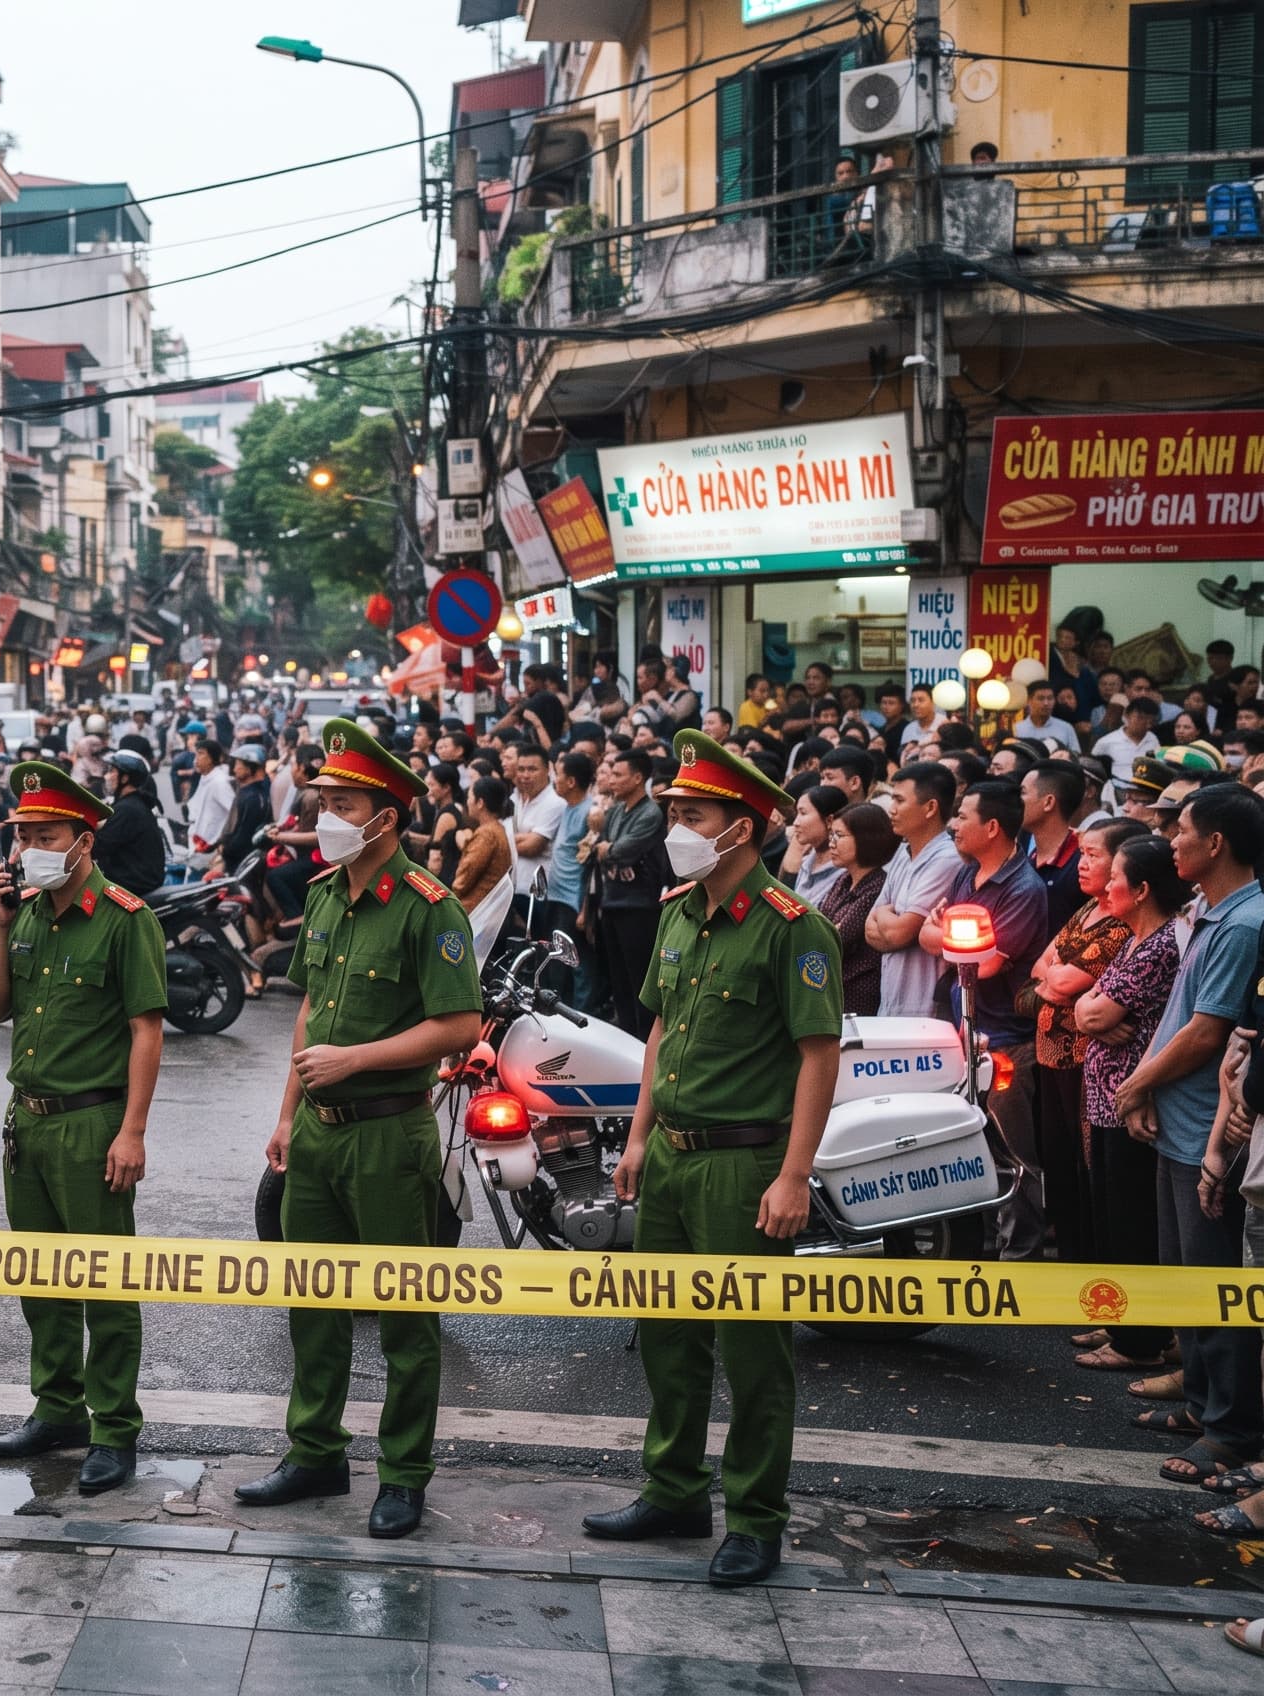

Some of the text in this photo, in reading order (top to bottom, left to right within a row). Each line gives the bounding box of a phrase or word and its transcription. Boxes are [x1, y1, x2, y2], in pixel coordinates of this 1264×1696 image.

[642, 441, 896, 519] CỬA HÀNG BÁNH MÌ
[1003, 425, 1060, 480] CỬA
[1069, 430, 1148, 479] HÀNG
[1156, 427, 1237, 477] BÁNH
[1087, 482, 1264, 527] PHỞ GIA TRU
[907, 1167, 938, 1192] GIAO
[940, 1156, 985, 1184] THÔNG
[121, 1252, 204, 1293] LINE
[218, 1255, 269, 1297] DO
[283, 1258, 361, 1299] NOT
[373, 1260, 503, 1305] CROSS
[569, 1255, 677, 1309] CẢNH
[691, 1262, 767, 1312] SÁT
[781, 1273, 924, 1316] PHONG
[937, 1264, 1021, 1318] TỎA
